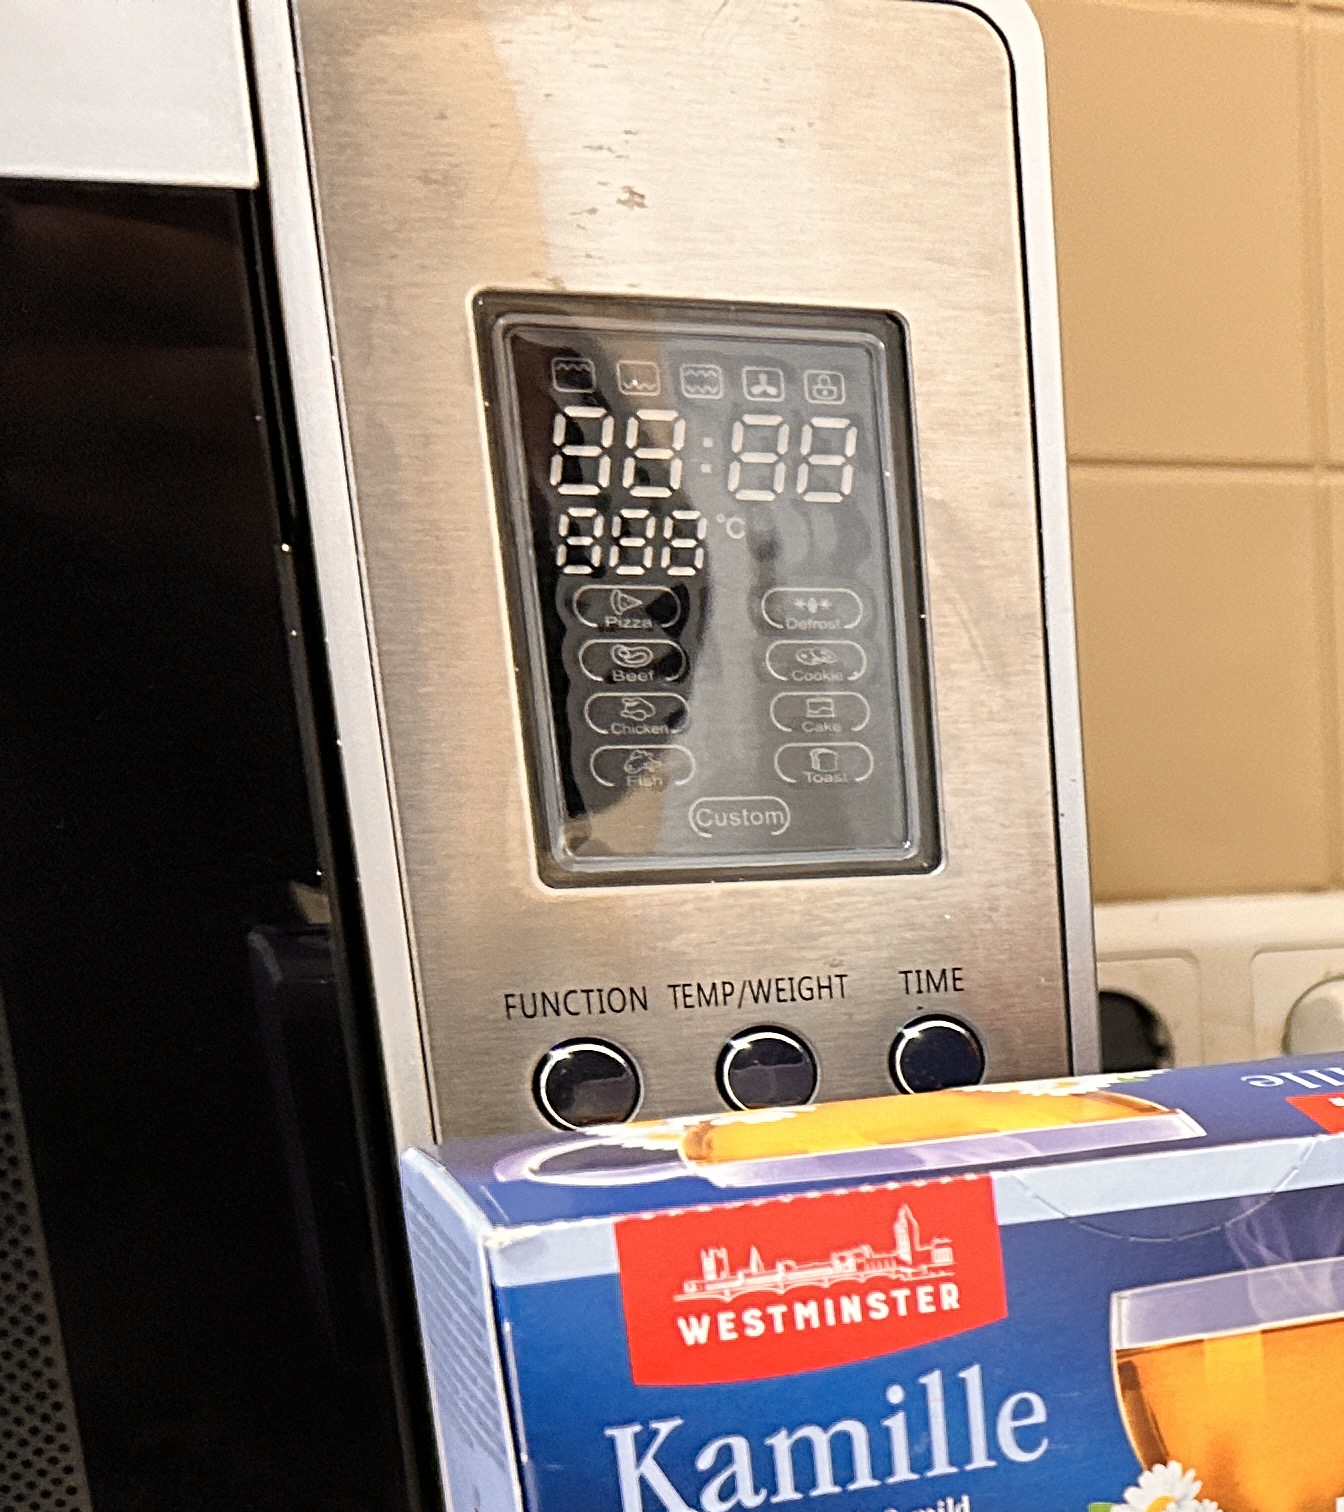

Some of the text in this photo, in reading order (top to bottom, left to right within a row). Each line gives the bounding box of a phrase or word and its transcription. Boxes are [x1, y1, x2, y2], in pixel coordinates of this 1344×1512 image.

[556, 507, 708, 576] 888
[605, 616, 653, 629] Pizza
[786, 618, 842, 630] Defrost
[612, 670, 654, 682] Beef
[791, 671, 844, 682] Cookie
[611, 722, 671, 735] Chicken
[801, 722, 842, 733] Cake
[625, 775, 664, 788] Fish
[803, 771, 848, 783] Toast
[695, 807, 786, 827] Custom
[899, 967, 965, 995] TIME
[667, 974, 849, 1010] TEMP/WEIGHT
[504, 985, 648, 1020] FUNCTION
[676, 1282, 961, 1346] WESTMINSTER
